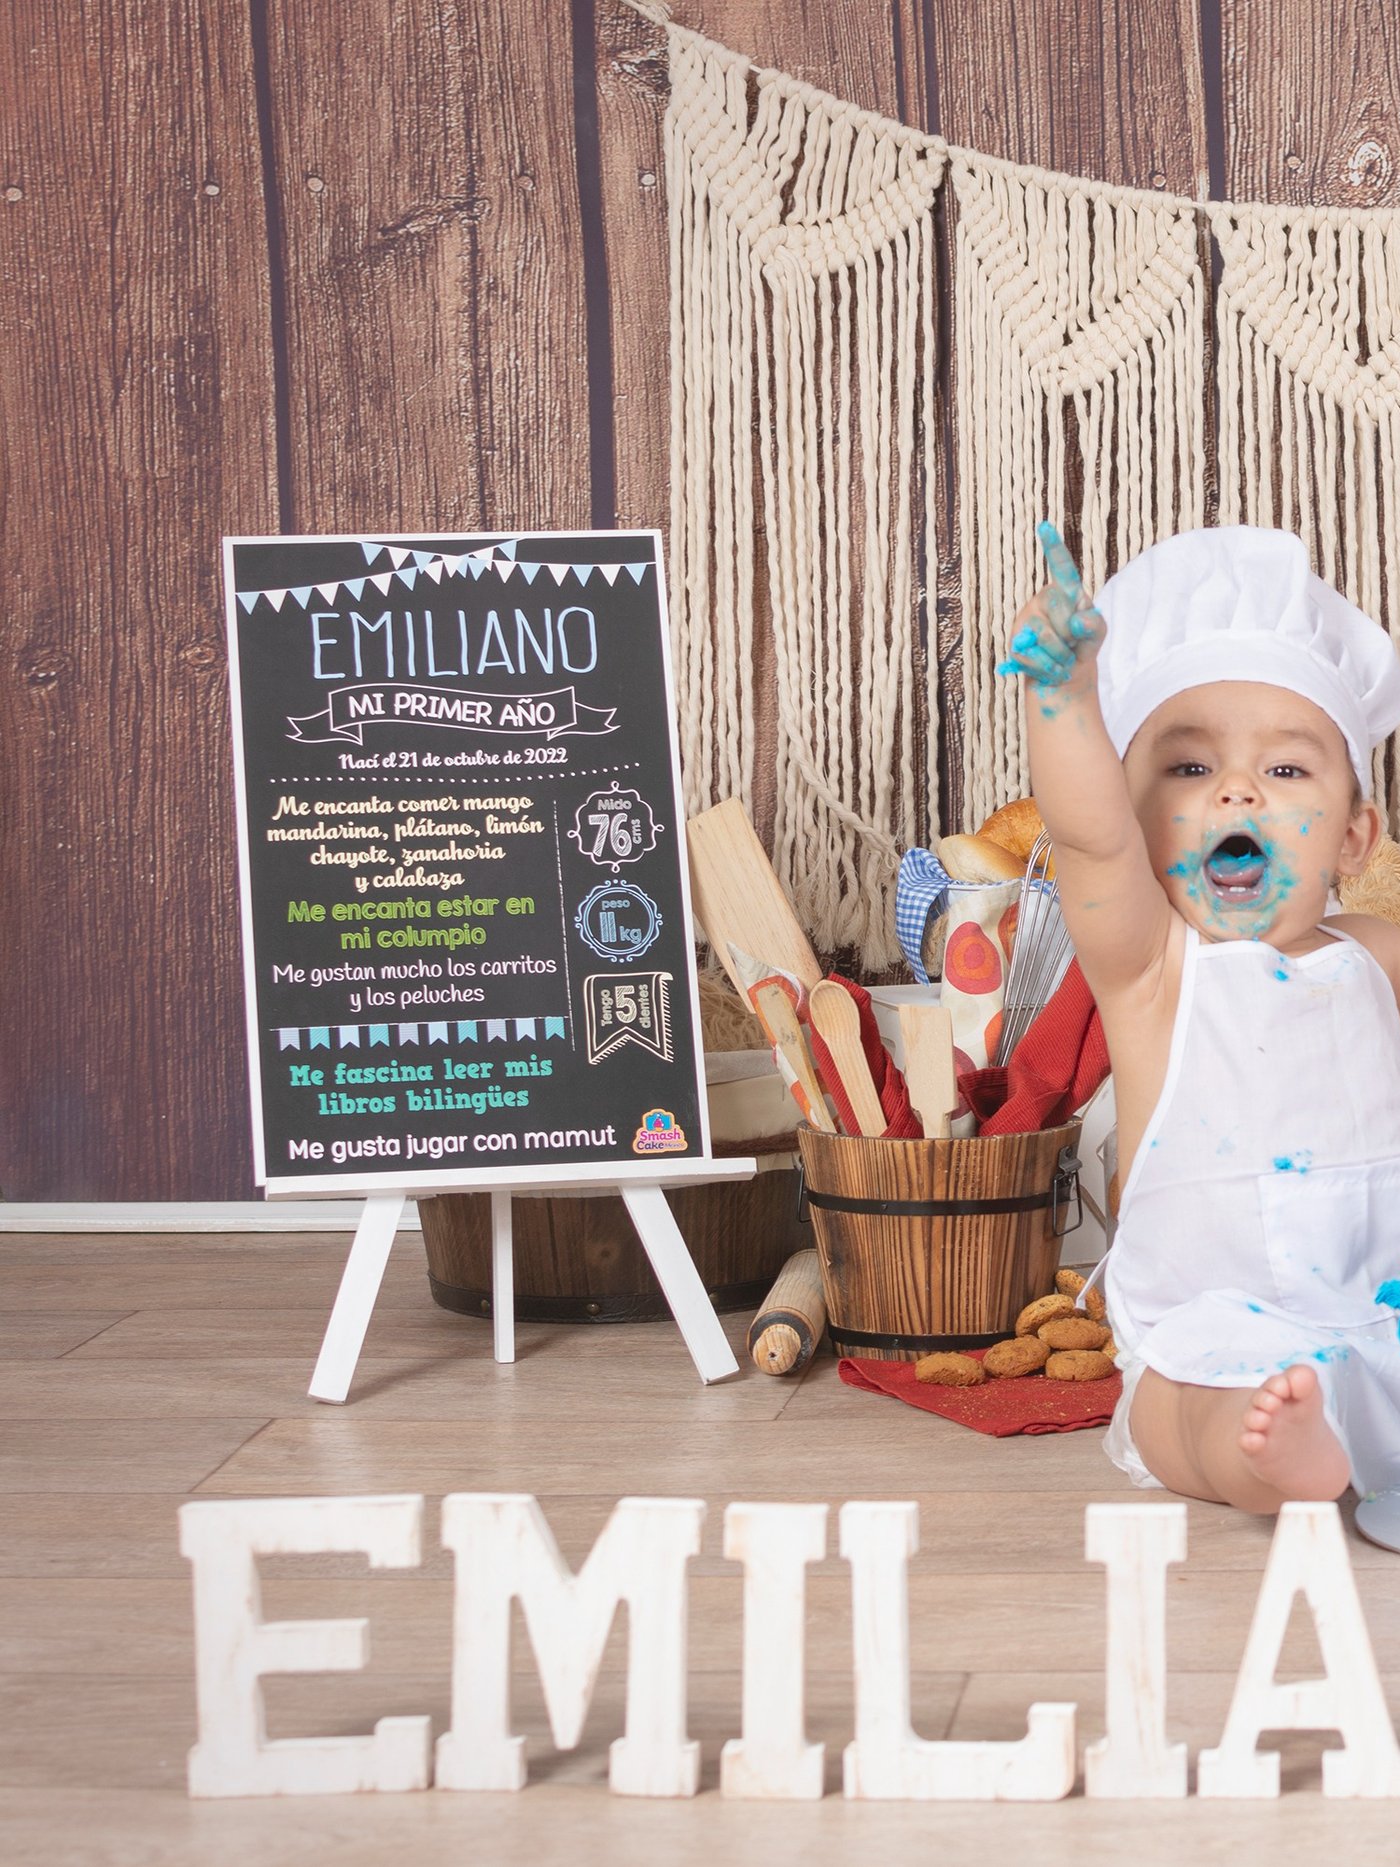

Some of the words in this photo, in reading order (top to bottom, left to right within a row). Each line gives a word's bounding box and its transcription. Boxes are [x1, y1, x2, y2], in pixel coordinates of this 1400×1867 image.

[311, 607, 597, 679] EMILIANO
[349, 693, 385, 718] MI
[394, 692, 492, 725] PRIMER
[499, 698, 555, 727] AÑO
[338, 754, 380, 769] Nací
[382, 752, 397, 768] el
[398, 752, 417, 768] 21
[422, 753, 442, 767] de
[444, 750, 501, 766] octubre
[503, 750, 523, 764] de
[524, 747, 568, 764] 2022
[272, 796, 311, 820] Me
[314, 796, 394, 815] encanta
[398, 796, 460, 812] comer
[463, 797, 534, 814] mango
[597, 799, 633, 811] Mido
[267, 821, 388, 841] mandarina,
[394, 817, 480, 842] plátano,
[486, 814, 544, 834] limón
[588, 813, 632, 857] 76
[631, 818, 642, 845] cms
[310, 845, 395, 868] chayote,
[402, 840, 506, 867] zanahoria
[355, 877, 369, 893] y
[373, 866, 465, 890] calabaza
[288, 901, 326, 922] Me
[332, 897, 431, 920] encanta
[437, 895, 499, 917] estar
[506, 897, 534, 914] en
[601, 900, 630, 911] peso
[341, 927, 371, 949] mi
[377, 923, 486, 950] columpio
[599, 912, 617, 943] 11
[619, 926, 643, 944] kg
[273, 964, 306, 983] Me
[311, 962, 376, 987] gustan
[381, 959, 442, 979] mucho
[448, 958, 476, 976] los
[481, 955, 557, 975] carritos
[350, 993, 361, 1012] y
[367, 987, 395, 1005] los
[401, 984, 484, 1009] peluches
[600, 989, 615, 1027] Tengo
[614, 985, 638, 1024] 5
[638, 984, 651, 1029] dientes
[290, 1065, 324, 1086] Me
[335, 1060, 433, 1084] fascina
[444, 1059, 493, 1079] leer
[505, 1054, 552, 1077] mis
[318, 1092, 396, 1115] libros
[406, 1086, 529, 1114] bilingües
[289, 1139, 324, 1159] Me
[331, 1136, 400, 1163] gusta
[406, 1134, 468, 1159] jugar
[473, 1133, 517, 1151] con
[524, 1125, 617, 1149] mamut
[636, 1141, 664, 1150] Cake
[640, 1128, 681, 1141] Smash
